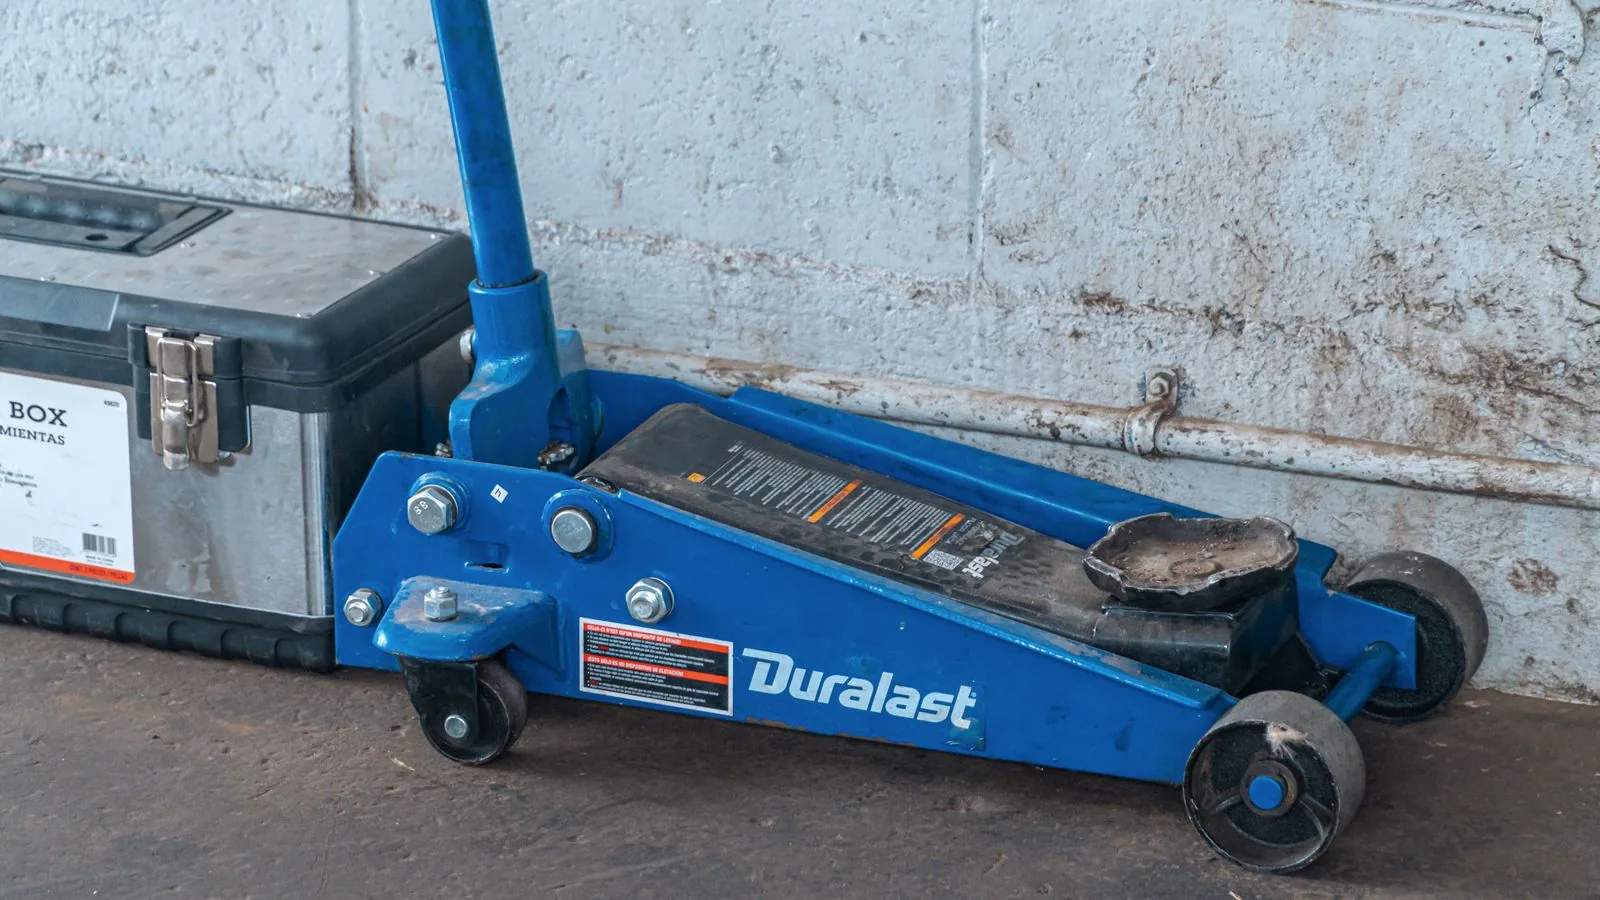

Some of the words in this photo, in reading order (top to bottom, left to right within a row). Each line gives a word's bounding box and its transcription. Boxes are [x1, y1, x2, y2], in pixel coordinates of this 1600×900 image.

[9, 401, 67, 427] BOX
[0, 425, 65, 446] MIENTAS
[742, 648, 977, 729] Duralast
